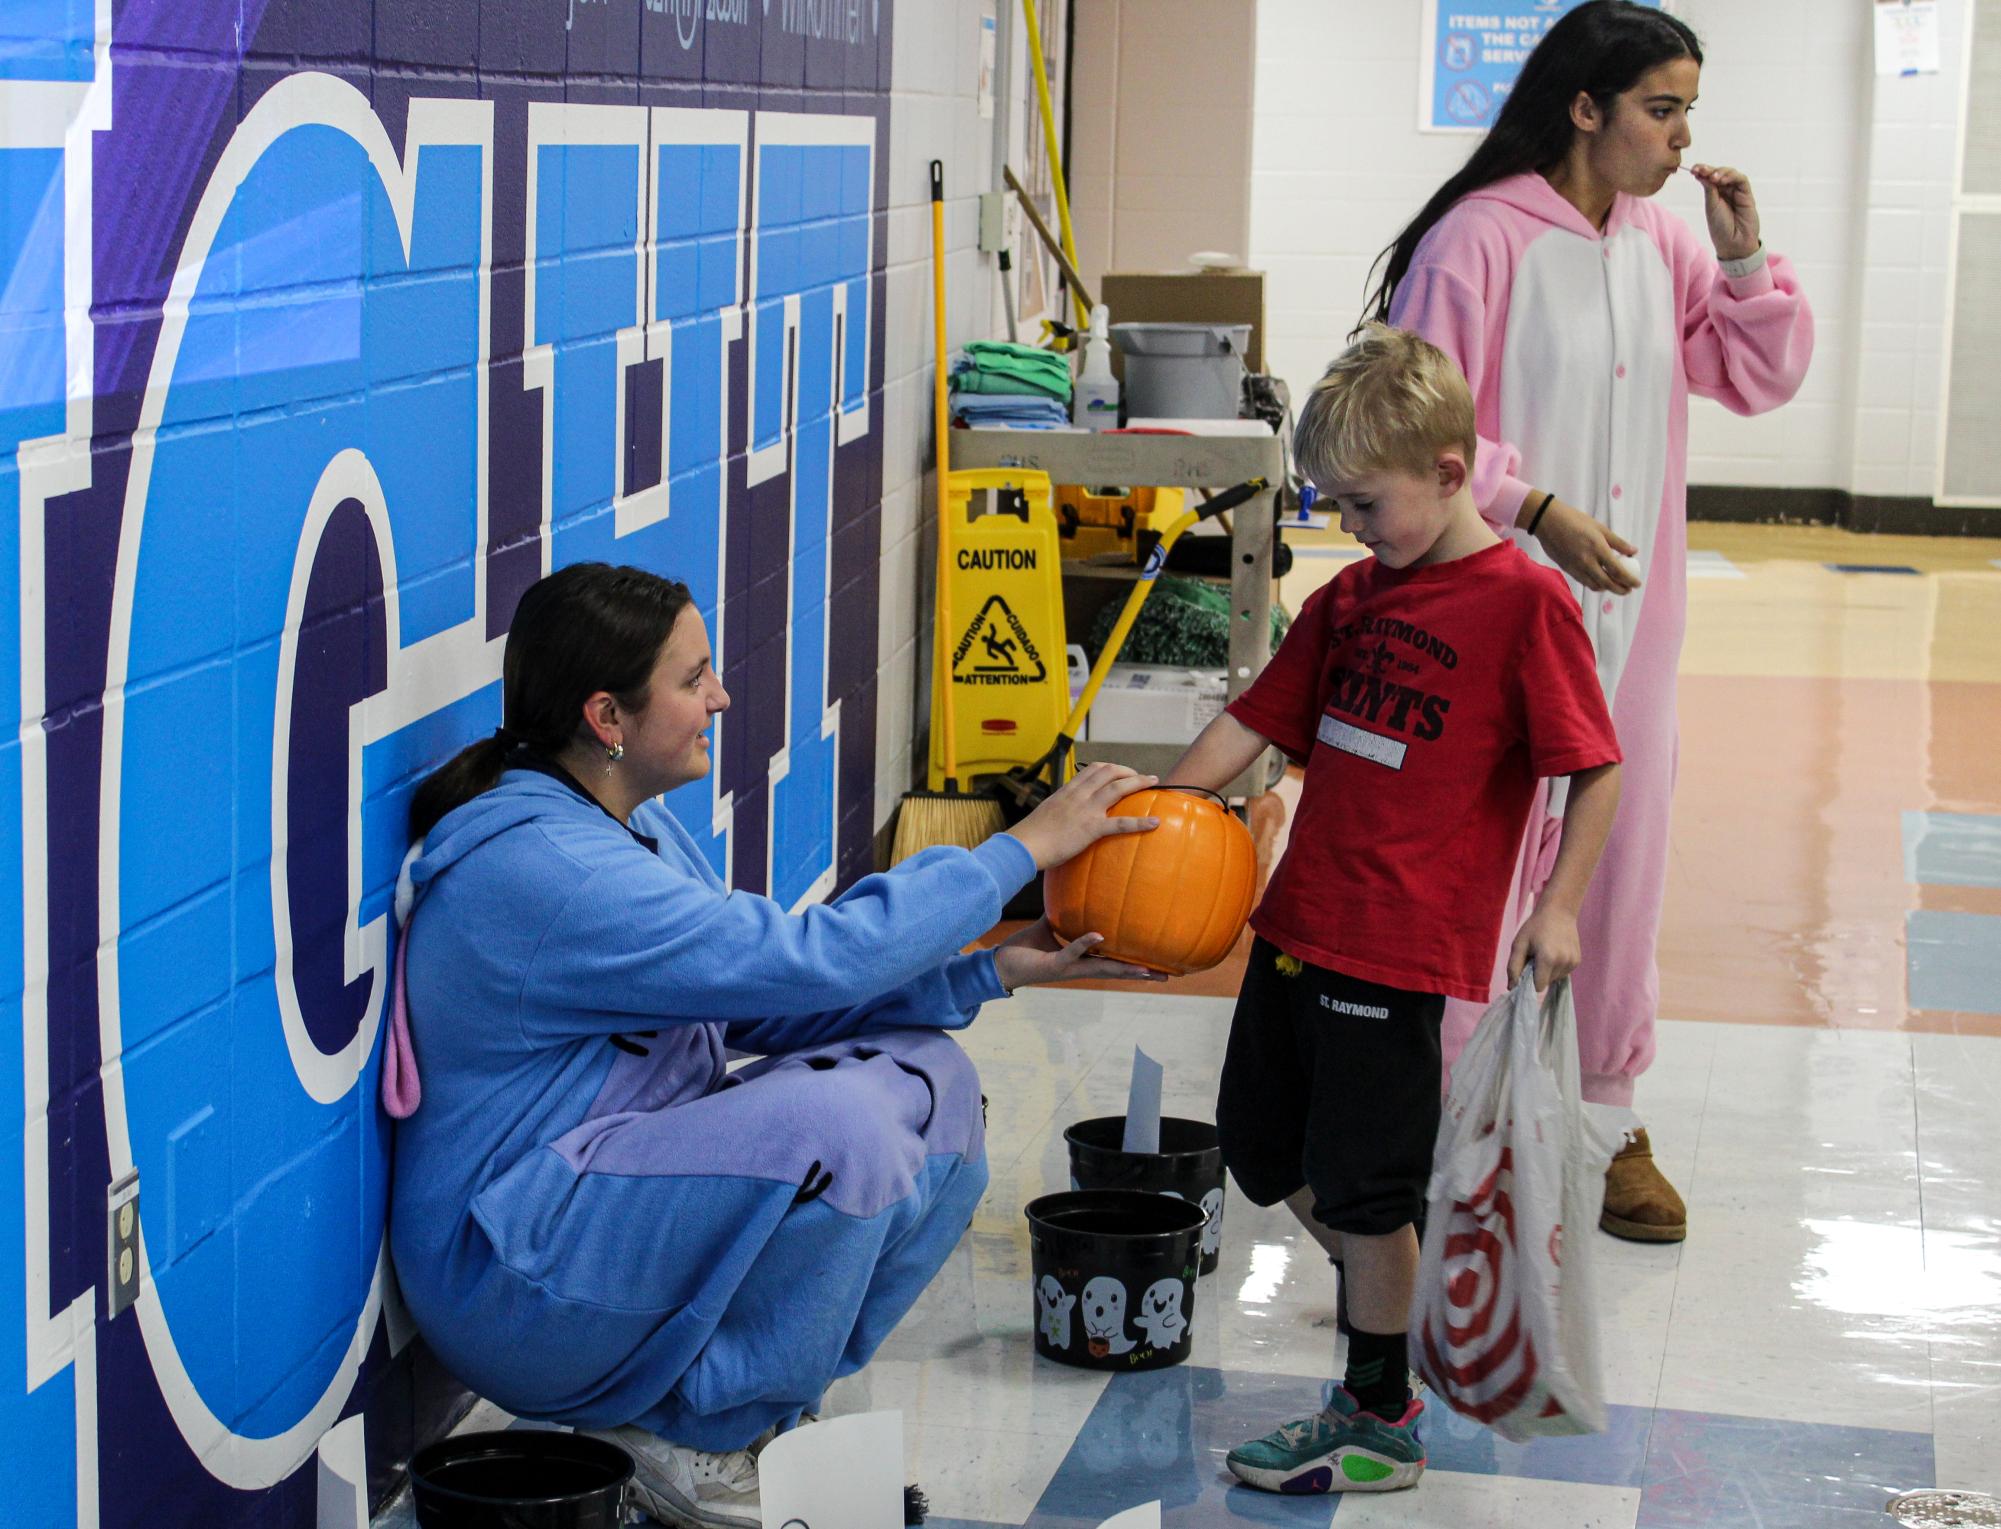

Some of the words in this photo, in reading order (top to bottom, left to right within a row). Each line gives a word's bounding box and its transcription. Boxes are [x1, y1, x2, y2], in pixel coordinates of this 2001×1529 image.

[1449, 14, 1500, 30] ITEMS
[1505, 15, 1541, 30] NOT
[1481, 32, 1515, 46] THE
[957, 549, 1036, 570] CAUTION
[953, 614, 986, 662] CAUTION
[1006, 614, 1040, 661] CUIDADO
[964, 674, 1029, 685] ATTENTION
[1319, 994, 1330, 1009] ST.
[1332, 999, 1389, 1020] RAYMOND
